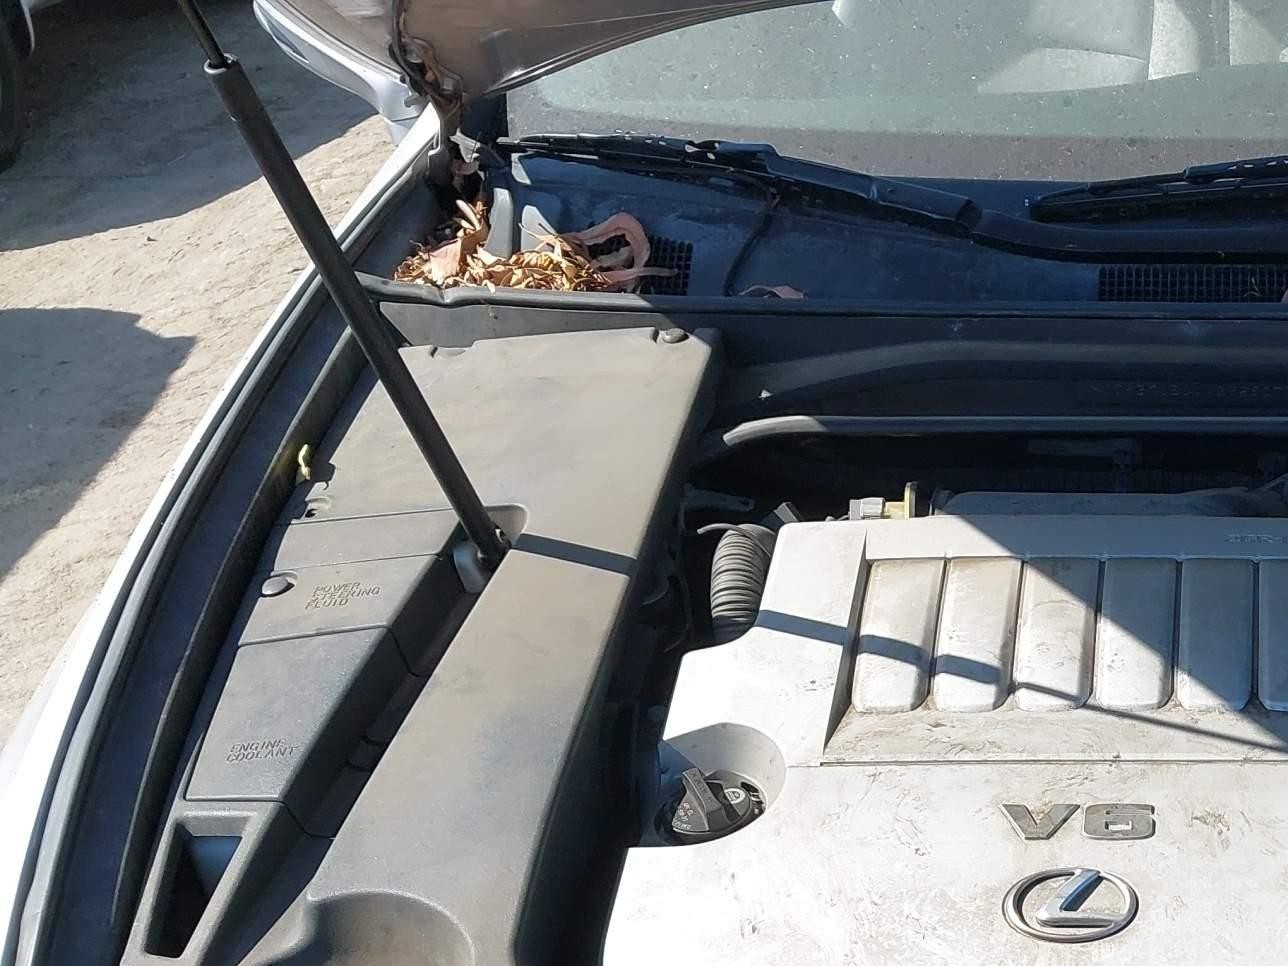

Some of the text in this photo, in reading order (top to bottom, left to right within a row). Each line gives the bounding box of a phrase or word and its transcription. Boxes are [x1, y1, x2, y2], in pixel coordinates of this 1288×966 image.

[311, 586, 381, 602] STEERING
[312, 582, 361, 598] POWER
[304, 598, 349, 610] FLUID
[226, 745, 300, 762] COOLANT
[230, 738, 287, 754] ENGINE
[1000, 802, 1157, 841] V6
